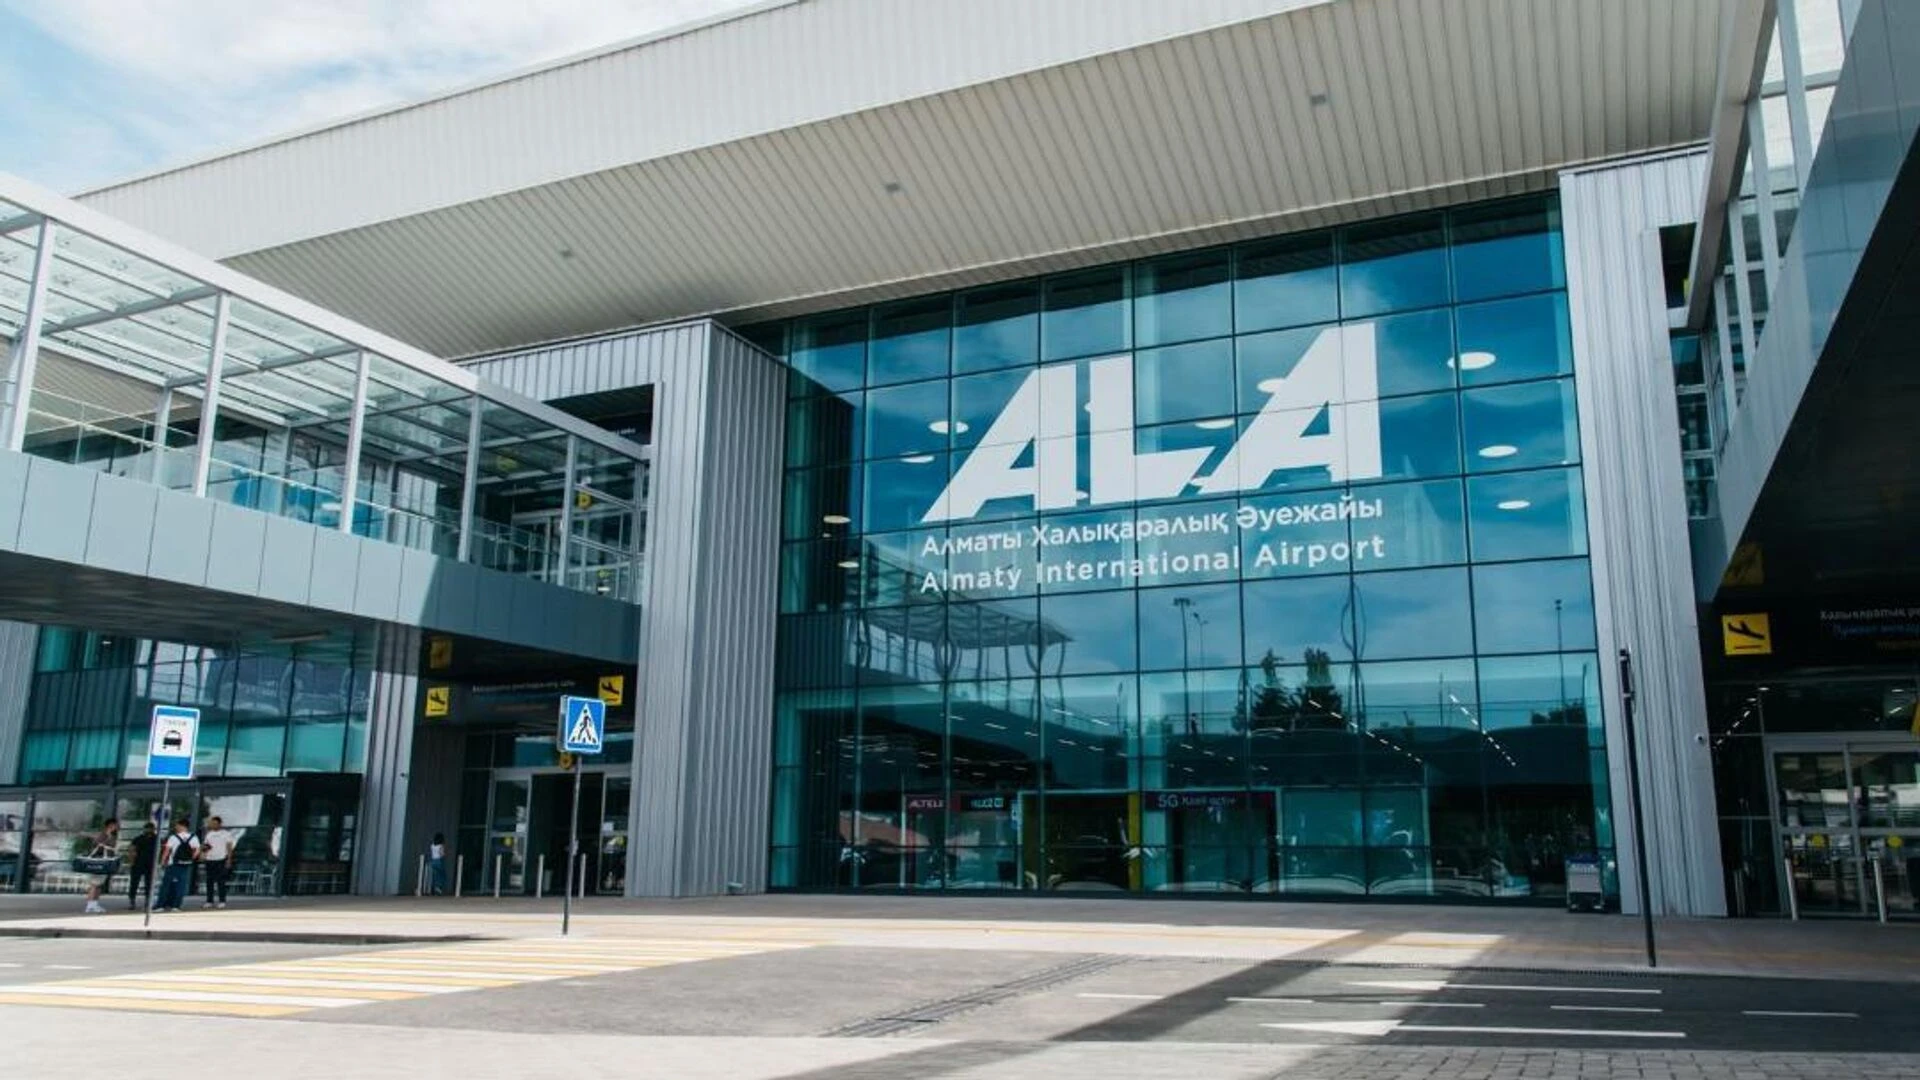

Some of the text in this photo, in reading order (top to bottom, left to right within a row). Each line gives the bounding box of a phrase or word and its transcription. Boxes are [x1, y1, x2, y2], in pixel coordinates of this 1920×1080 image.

[921, 322, 1383, 523] ALA
[922, 492, 1383, 557] Алматы Халықаралық Әуежайы
[920, 534, 1385, 593] Almaty International Airport
